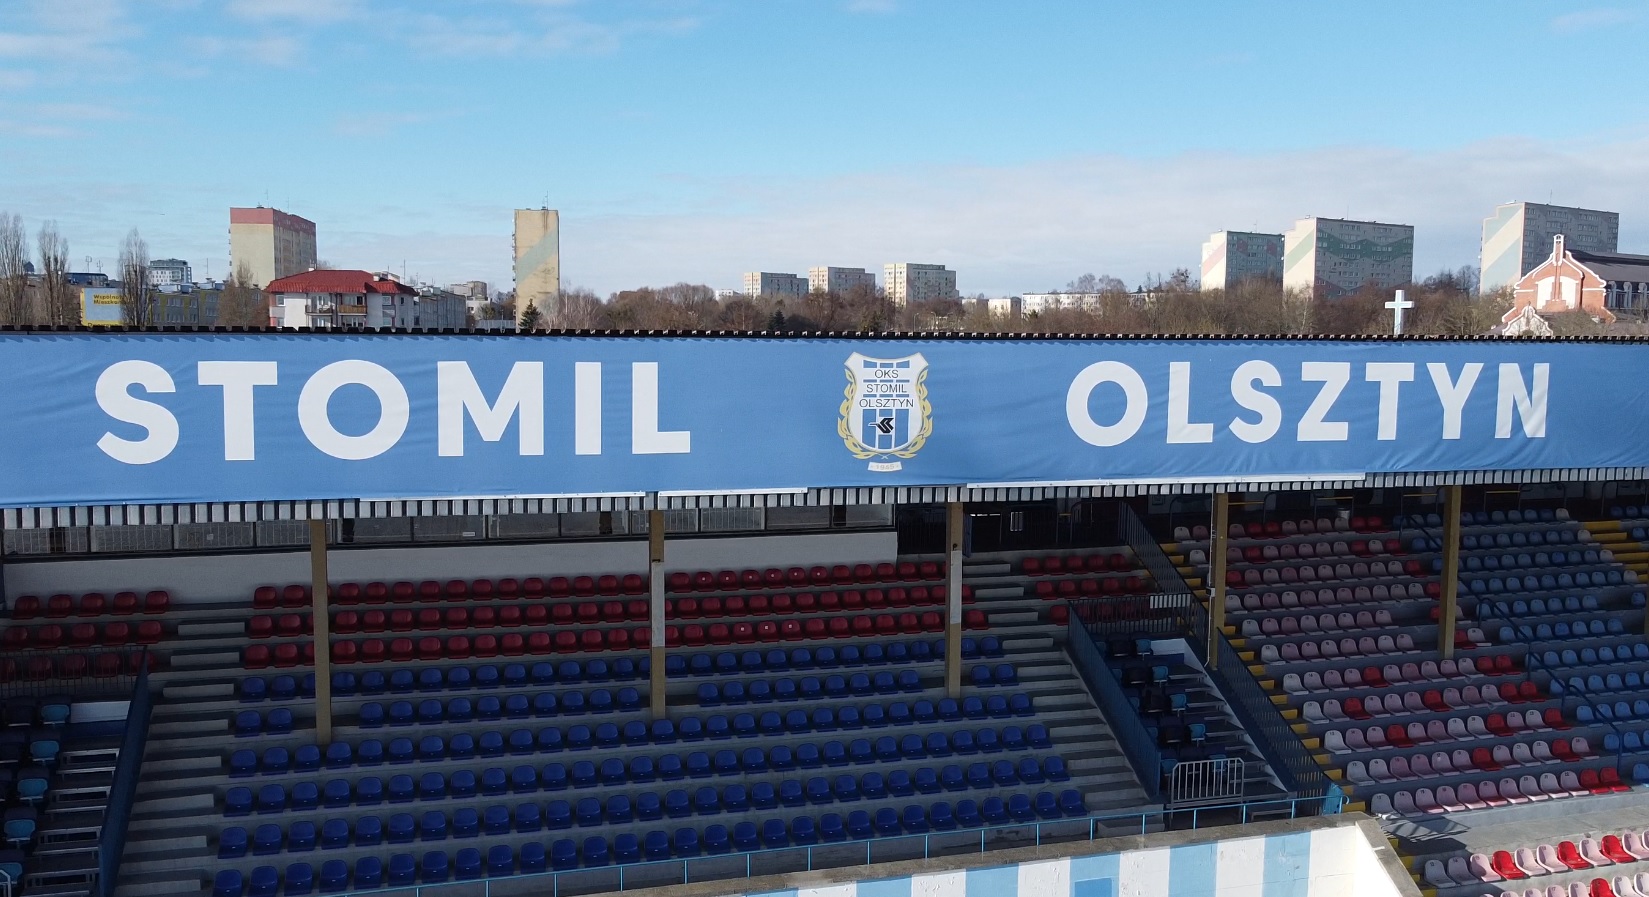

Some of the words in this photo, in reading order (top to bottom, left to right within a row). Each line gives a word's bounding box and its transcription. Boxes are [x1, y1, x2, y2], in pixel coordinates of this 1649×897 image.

[874, 369, 899, 379] OKS
[866, 383, 908, 393] STOMIL
[859, 398, 914, 408] OLSZTYN
[96, 360, 691, 464] STOMIL
[1066, 360, 1550, 446] OLSZTYN
[875, 463, 895, 471] 1945
